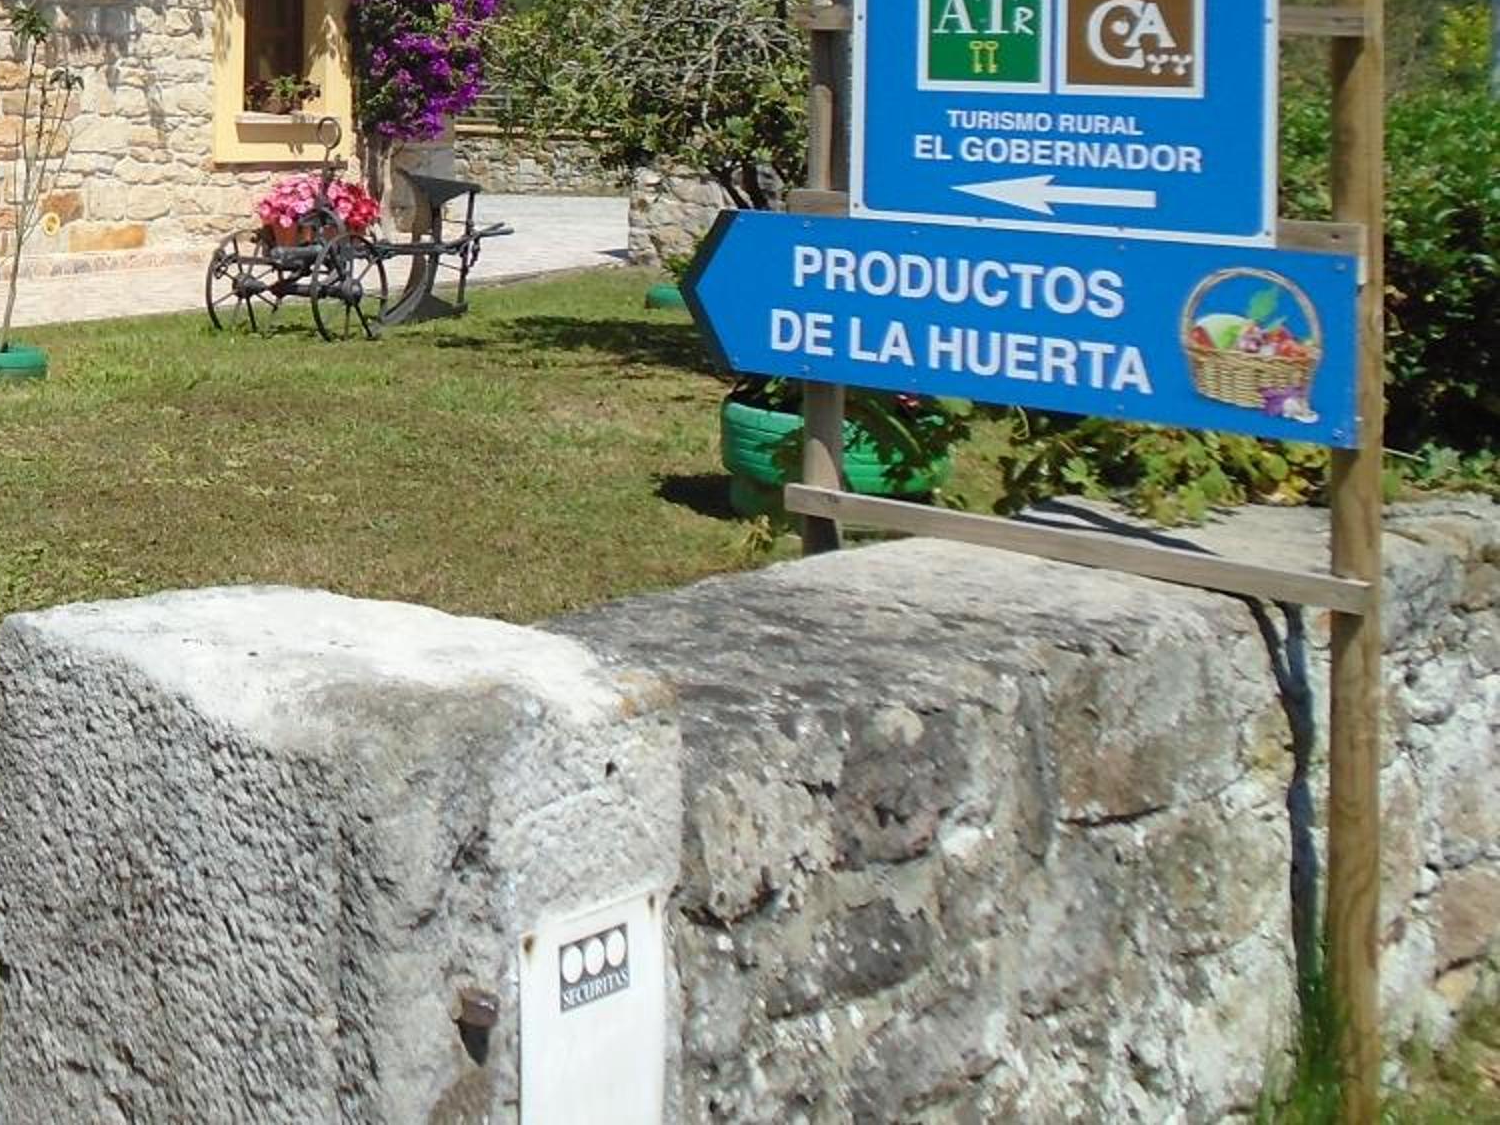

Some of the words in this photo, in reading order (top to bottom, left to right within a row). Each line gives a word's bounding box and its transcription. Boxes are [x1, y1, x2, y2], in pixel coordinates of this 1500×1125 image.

[947, 109, 1052, 132] TURISMO
[1058, 114, 1144, 136] RURAL
[914, 134, 953, 161] EL
[960, 137, 1203, 174] GOBERNADOR
[792, 244, 1125, 319] PRODUCTOS
[769, 308, 835, 357] DE
[849, 316, 915, 367] LA
[928, 324, 1154, 396] HUERTA
[563, 967, 629, 1009] SECURITAS
